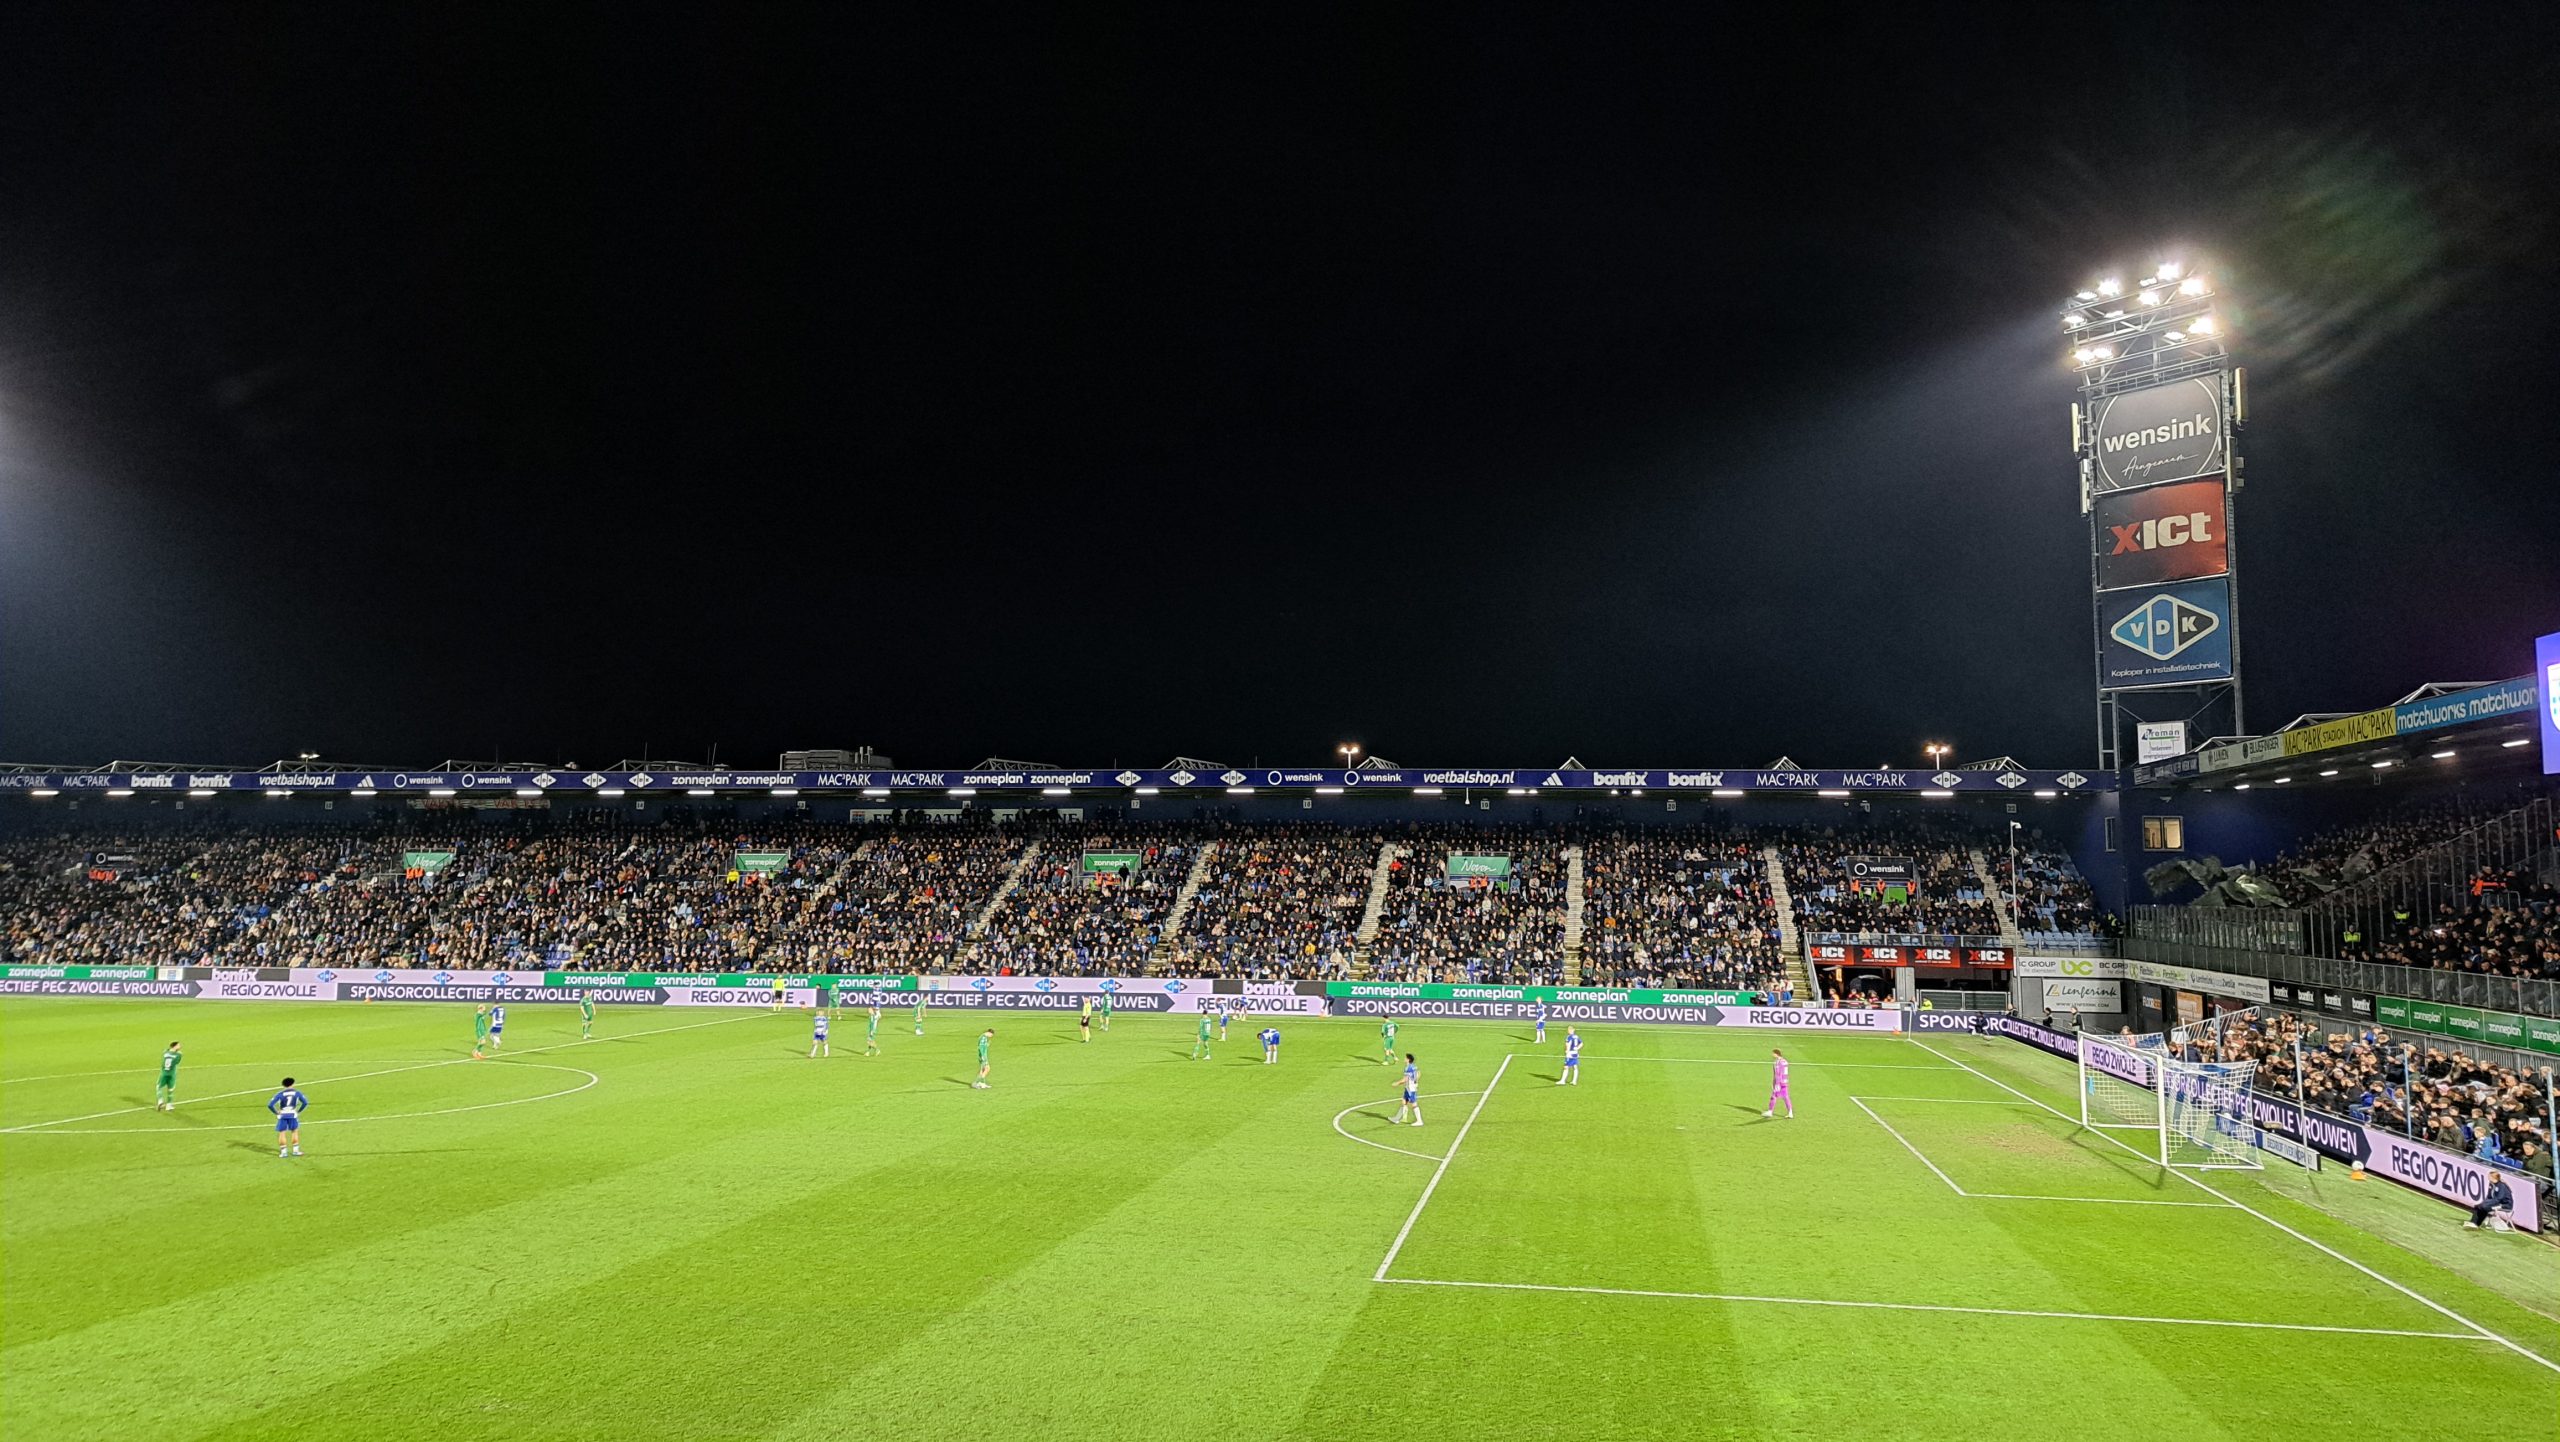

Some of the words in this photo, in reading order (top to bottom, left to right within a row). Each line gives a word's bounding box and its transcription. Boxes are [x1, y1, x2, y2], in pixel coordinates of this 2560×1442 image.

[2104, 413, 2212, 453] wensink
[2111, 669, 2143, 679] Koploper
[2153, 661, 2221, 674] installatietechniek
[2469, 687, 2537, 716] matchwor
[2397, 704, 2466, 730] matchworks
[2323, 728, 2345, 743] STADION
[131, 774, 173, 788] bonfix
[189, 774, 232, 788] bonfix
[260, 774, 335, 788] voetbalshop.nl
[409, 776, 444, 785] wensink
[477, 776, 512, 785] wensink
[672, 774, 730, 787] zonneplan
[735, 774, 796, 787] zonneplan
[963, 773, 1026, 786] zonneplan
[1030, 772, 1093, 786] zonneplan
[1284, 772, 1324, 782] wensink
[1362, 772, 1402, 782] wensink
[1423, 771, 1514, 786] voetbalshop.nl
[1593, 772, 1647, 786] bonfix
[1668, 772, 1723, 786] bonfix
[1094, 858, 1131, 868] zonneplan
[1869, 864, 1905, 873] wensink
[8, 967, 65, 979] zonneplan
[90, 967, 148, 979] zonneplan
[212, 968, 259, 982] bonfix
[42, 980, 66, 993] PEC
[69, 981, 120, 993] ZWOLLE
[123, 982, 189, 995] VROUWEN
[564, 974, 628, 987] zonneplan
[654, 974, 718, 987] zonneplan
[745, 976, 811, 989] zonnplan
[221, 985, 262, 997] REGIO
[264, 985, 317, 998] ZWOLLE
[351, 986, 491, 1000] SPONSORCOLLECTIEF
[495, 988, 522, 1000] PEC
[525, 988, 580, 1001] ZWOLLE
[1243, 981, 1297, 995] bonfix
[1351, 984, 1421, 998] zonneplan
[1452, 986, 1524, 1001] zonneplan
[2061, 985, 2118, 998] Lenferink
[691, 990, 734, 1003] REGIO
[737, 991, 794, 1004] ZWOE
[987, 994, 1013, 1007] PEC
[1018, 995, 1077, 1008] ZWOLLE
[1556, 988, 1631, 1003] zonneplan
[1662, 992, 1739, 1006] zonneplan
[1247, 998, 1307, 1012] ZWOLLE
[1347, 1000, 1513, 1017] SPONSORCOLLECTIEF
[1518, 1004, 1546, 1018] PE
[1552, 1005, 1617, 1020] ZWOLLE
[1621, 1006, 1707, 1022] VROUWEN
[1751, 1010, 1801, 1025] REGIO
[1804, 1011, 1875, 1028] ZWOLLE
[2532, 1029, 2560, 1045] zonnepl
[2092, 1046, 2109, 1067] REGIO
[2111, 1051, 2136, 1077] ZWOLLE
[2253, 1100, 2294, 1133] ZWOLLE
[2392, 1145, 2438, 1186] REGIO
